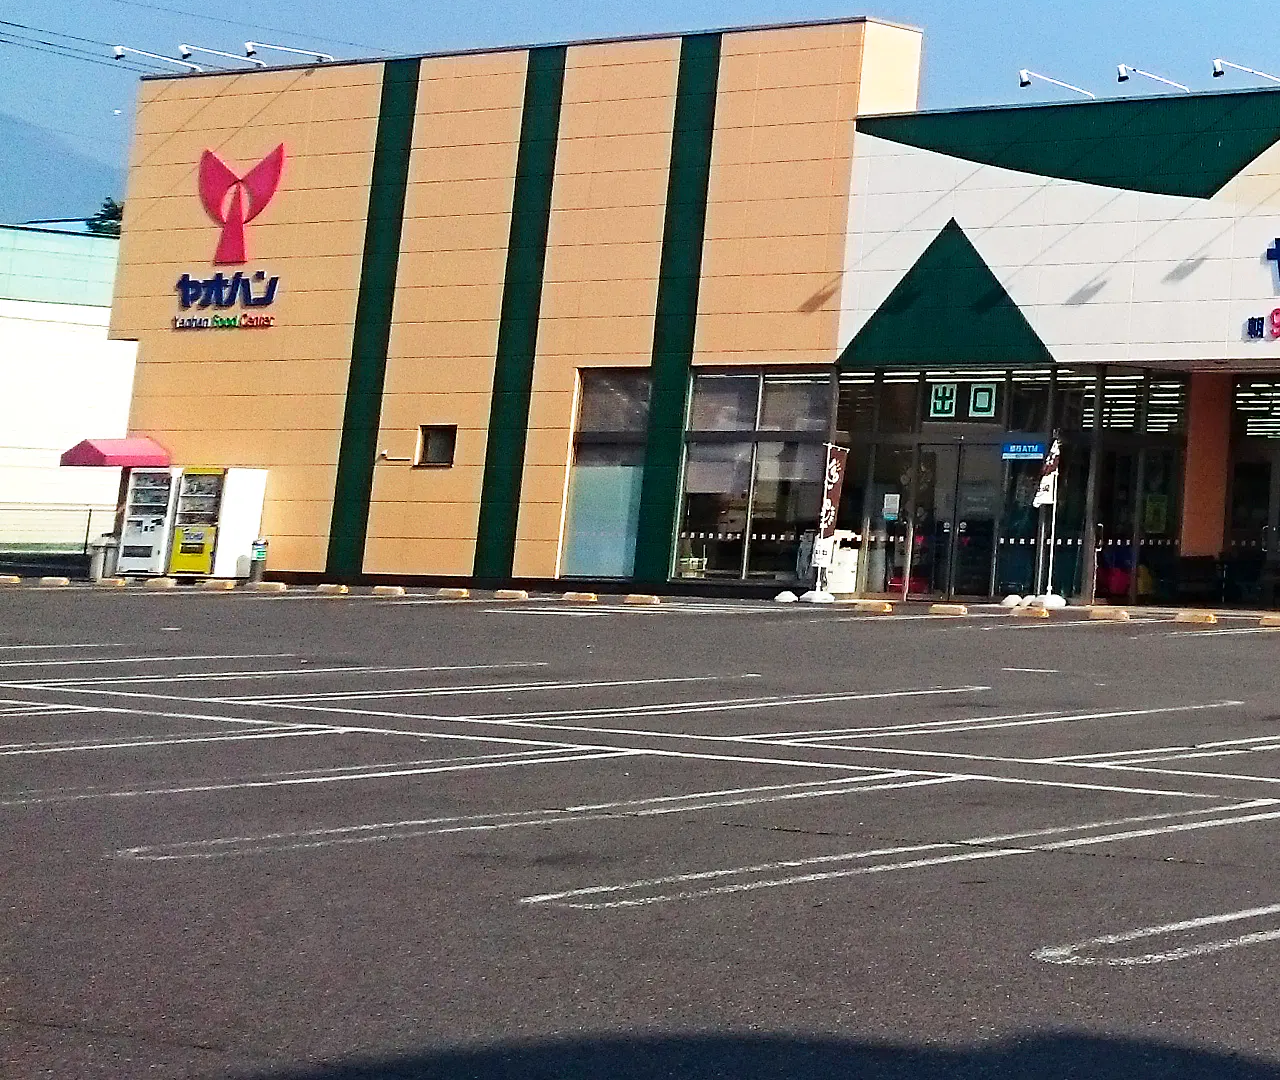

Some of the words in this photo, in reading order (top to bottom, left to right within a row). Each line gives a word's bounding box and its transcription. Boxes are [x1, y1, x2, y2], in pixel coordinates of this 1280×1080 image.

[176, 270, 279, 307] ヤオハン
[932, 385, 994, 414] 出口
